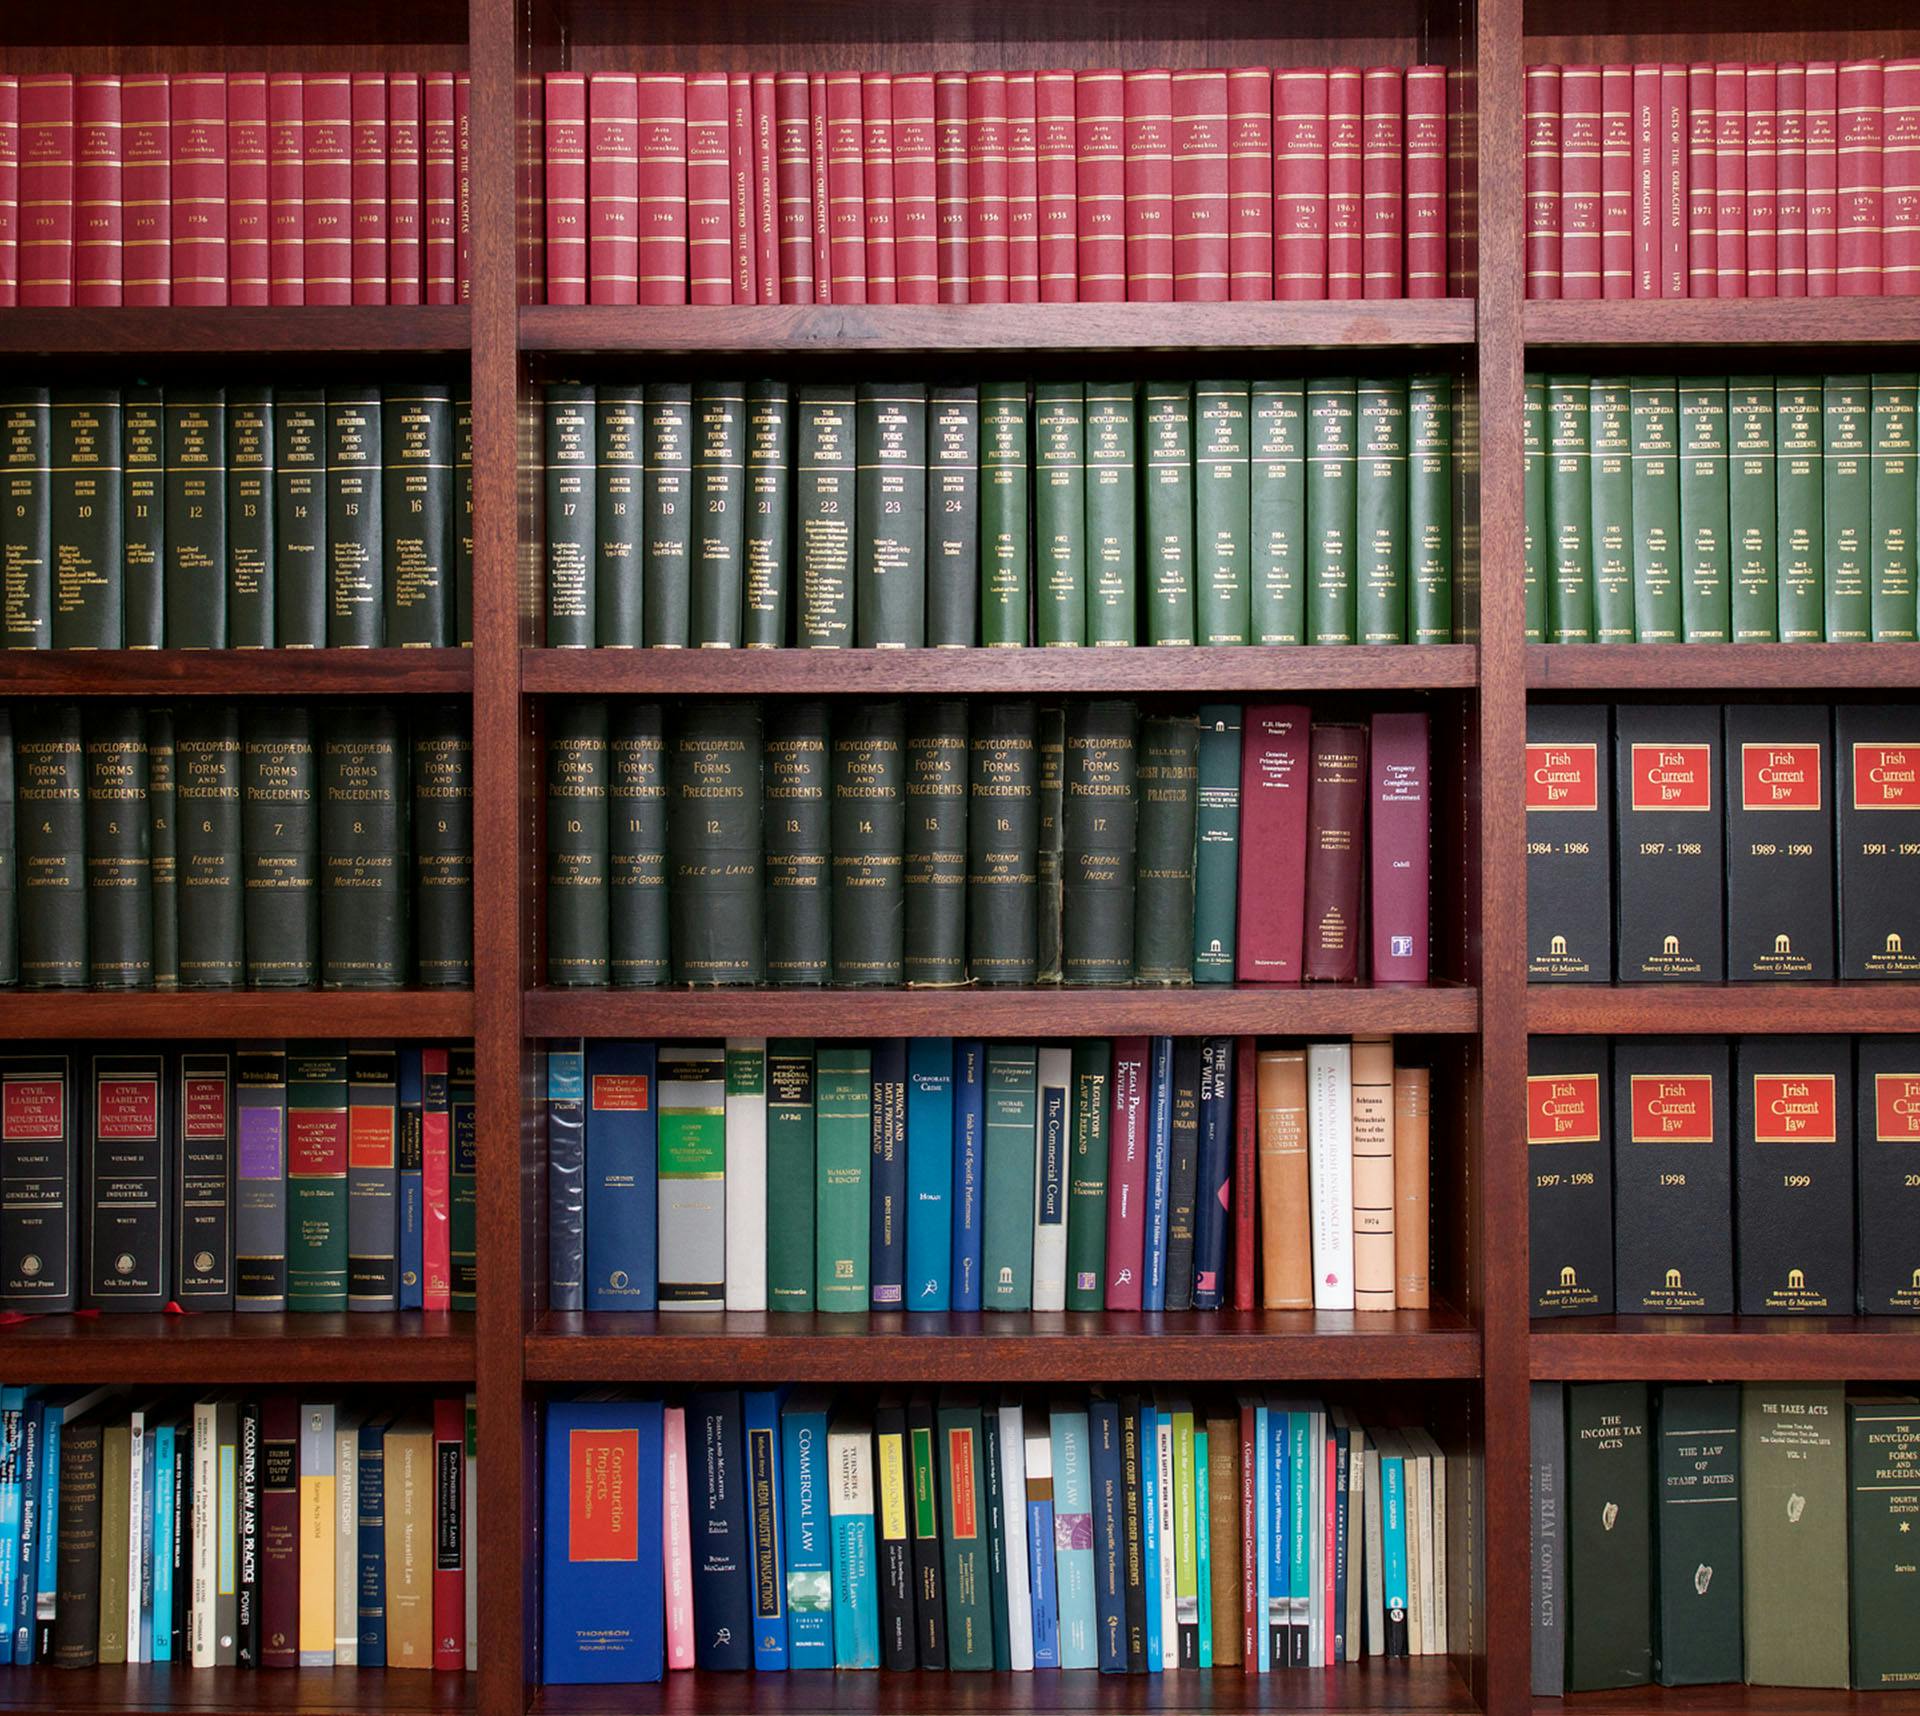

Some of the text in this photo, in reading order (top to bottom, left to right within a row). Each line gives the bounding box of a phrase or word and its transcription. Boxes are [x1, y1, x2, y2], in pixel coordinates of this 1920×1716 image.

[1854, 197, 1873, 205] 1976
[431, 217, 450, 225] 1942
[78, 505, 92, 517] 10
[190, 506, 202, 518] 12
[244, 505, 256, 517] 13
[345, 504, 359, 515] 15
[411, 500, 422, 512] 16
[564, 504, 576, 516] 17
[614, 504, 626, 515] 18
[662, 504, 674, 515] 19
[709, 500, 726, 512] 20
[758, 502, 772, 514] 21
[820, 502, 838, 513] 22
[885, 502, 901, 513] 23
[946, 500, 962, 512] 24
[1545, 752, 1571, 767] Irish
[1659, 752, 1685, 767] Irish
[1769, 752, 1795, 767] Irish
[340, 764, 377, 776] FORMS
[694, 762, 731, 774] FORMS
[1082, 760, 1120, 773] FORMS
[349, 778, 369, 786] AND
[1534, 769, 1581, 783] Current
[1648, 769, 1694, 783] Current
[1758, 769, 1804, 783] Current
[328, 787, 391, 800] PRECEDENTS
[682, 786, 744, 798] PRECEDENTS
[1070, 784, 1131, 796] PRECEDENTS
[1548, 785, 1568, 799] Law
[1661, 785, 1681, 799] Law
[1772, 785, 1792, 799] Law
[1527, 843, 1552, 854] 1984
[1564, 843, 1589, 854] 1986
[1640, 843, 1664, 854] 1987
[1677, 843, 1701, 854] 1988
[1752, 844, 1776, 855] 1989
[1788, 844, 1812, 856] 1990
[328, 857, 392, 866] LANDS CLAUSES
[679, 865, 707, 876] SALE
[726, 865, 754, 875] LAND
[1084, 870, 1115, 880] INDEX
[912, 1073, 950, 1082] CORPORATE
[992, 1068, 1032, 1076] Employment
[1201, 1048, 1212, 1100] OF WILLS
[1215, 1048, 1227, 1100] THE LAW
[873, 1082, 883, 1102] LAW
[1116, 1062, 1128, 1111] PRIVILEGE
[1552, 1083, 1575, 1098] Irish
[1659, 1083, 1686, 1098] Irish
[1782, 1083, 1809, 1098] Irish
[884, 1082, 893, 1105] DATA
[894, 1082, 904, 1142] PRIVACY AND
[1126, 1061, 1141, 1162] LEGAL PROFESSIONAL
[1541, 1100, 1585, 1115] Current
[1648, 1100, 1696, 1115] Current
[1771, 1100, 1819, 1114] Current
[1554, 1117, 1573, 1132] Law
[1662, 1117, 1683, 1131] Law
[1785, 1116, 1805, 1131] Law
[1045, 1098, 1060, 1216] The Commercial Court
[1536, 1174, 1560, 1186] 1997
[1571, 1173, 1594, 1185] 1998
[1660, 1175, 1686, 1185] 1998
[1783, 1175, 1810, 1186] 1999
[1762, 1404, 1828, 1415] THE TAXES ACTS
[1601, 1415, 1621, 1425] THE
[1580, 1426, 1642, 1439] INCOME TAX
[1598, 1438, 1623, 1449] ACTS
[1679, 1446, 1723, 1457] THE LAW
[1064, 1432, 1079, 1506] MEDIA LAW
[1695, 1461, 1708, 1471] OF
[1667, 1474, 1734, 1486] STAMP DUTIES
[611, 1447, 623, 1534] Construction
[799, 1428, 813, 1552] COMMERCIAL LAW
[242, 1417, 256, 1583] ACCOUNTING LAW AND PRACTICE
[1540, 1463, 1555, 1627] THE RIAI CONTRACTS
[240, 1591, 250, 1626] POWER
